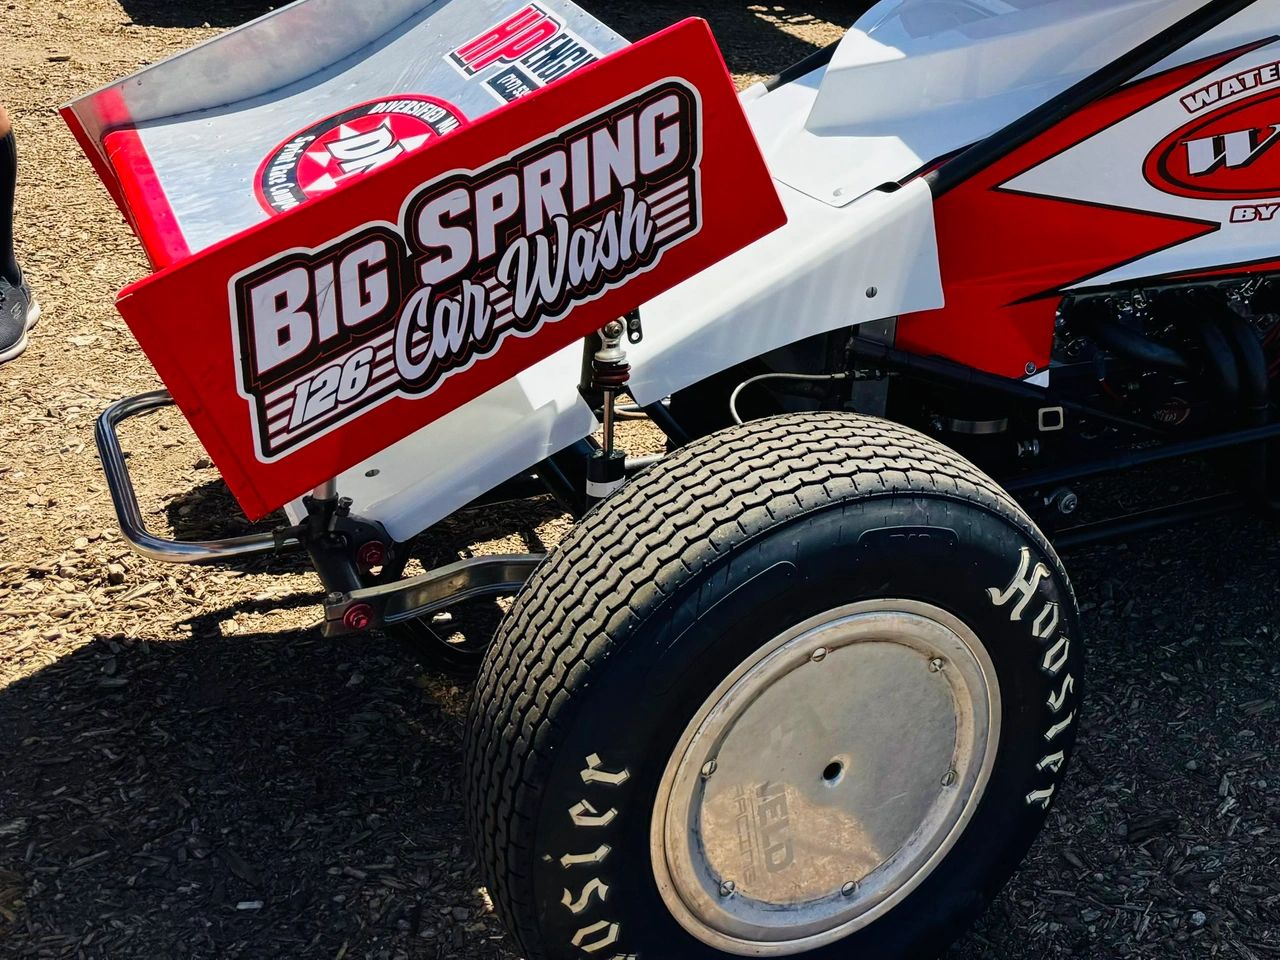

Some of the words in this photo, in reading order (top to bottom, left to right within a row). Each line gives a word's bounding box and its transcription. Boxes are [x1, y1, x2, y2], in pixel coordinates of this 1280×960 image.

[367, 100, 447, 123] DIVERSIFIED
[1229, 203, 1280, 222] BY
[250, 240, 391, 373] BIG
[417, 94, 682, 288] SPRING
[289, 348, 376, 432] 126
[393, 280, 493, 383] Car
[499, 189, 657, 319] Wash
[985, 546, 1072, 810] Hoosier
[542, 752, 641, 960] osier
